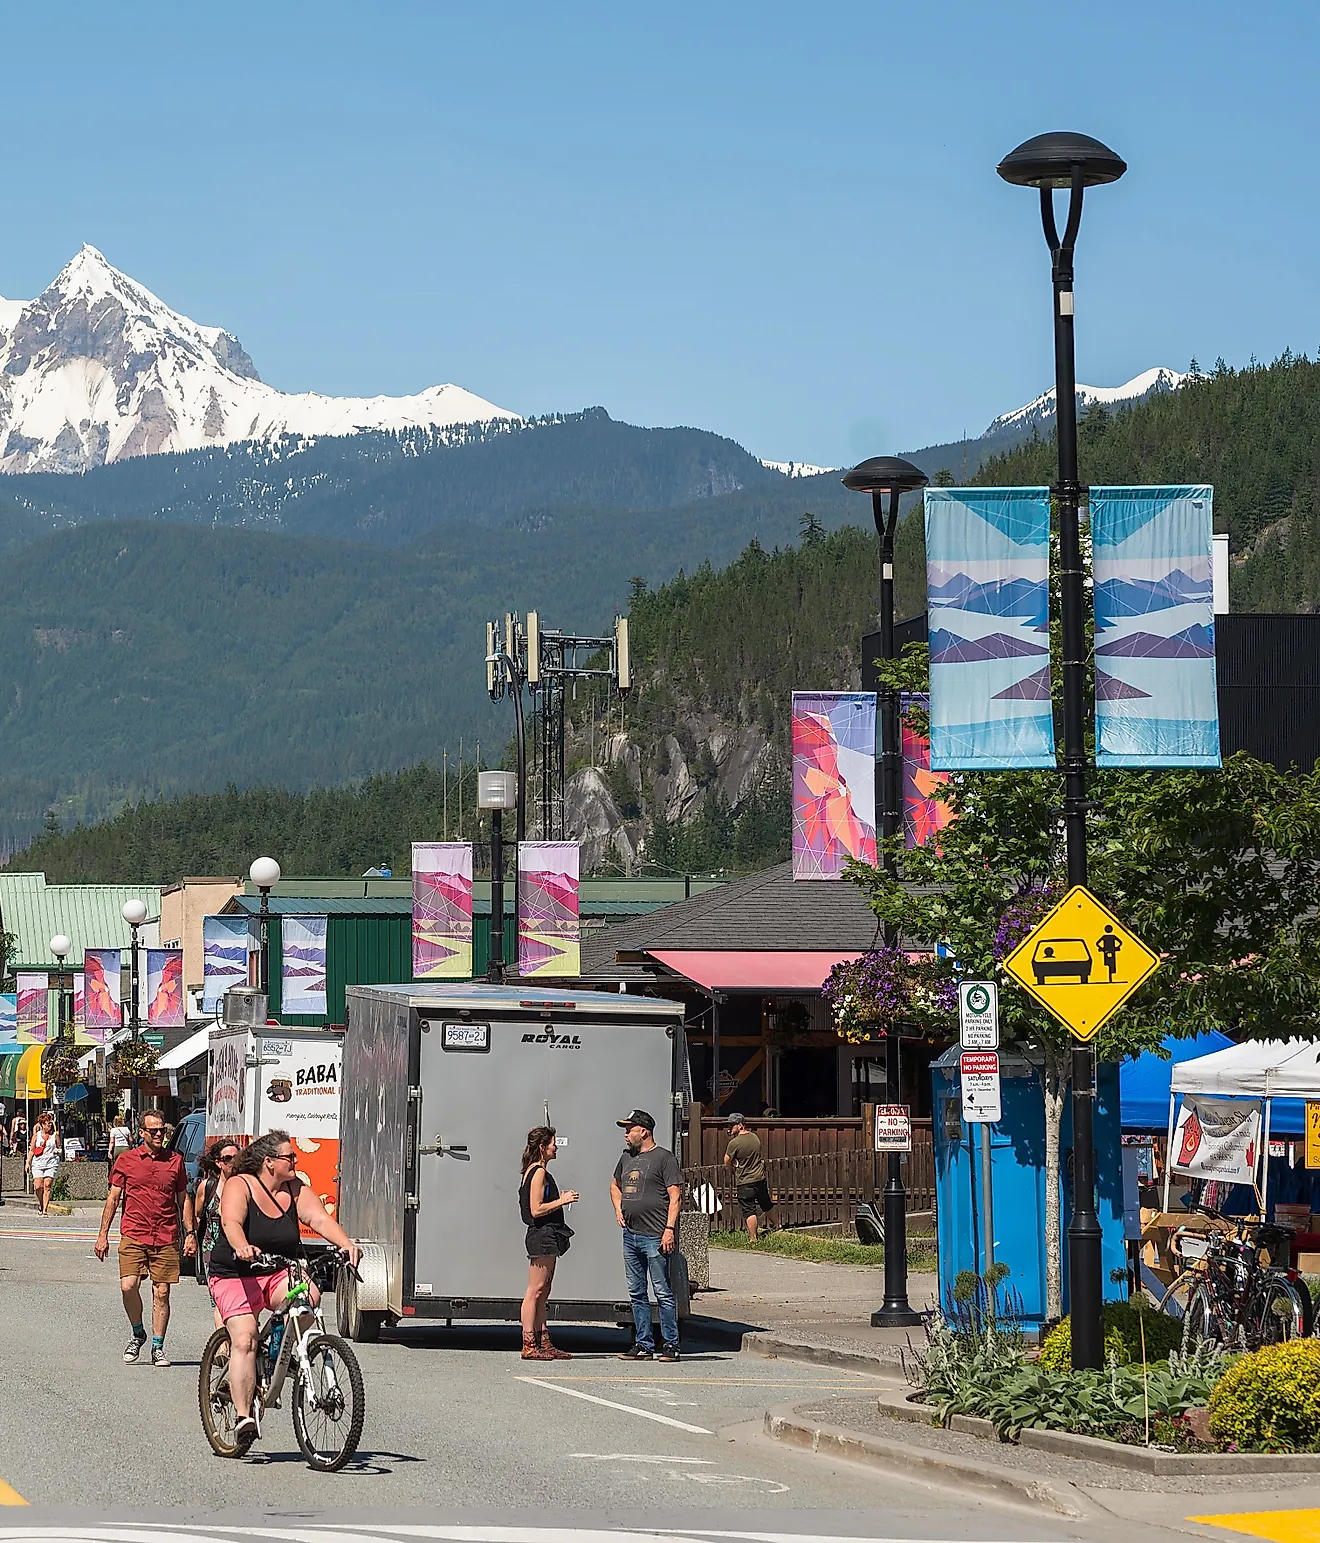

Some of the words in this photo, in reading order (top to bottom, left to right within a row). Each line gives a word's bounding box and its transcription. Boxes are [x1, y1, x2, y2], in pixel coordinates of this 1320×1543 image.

[521, 1034, 582, 1044] ROYAL
[296, 1062, 341, 1086] BABA'
[295, 1086, 336, 1096] TRADITIONAL
